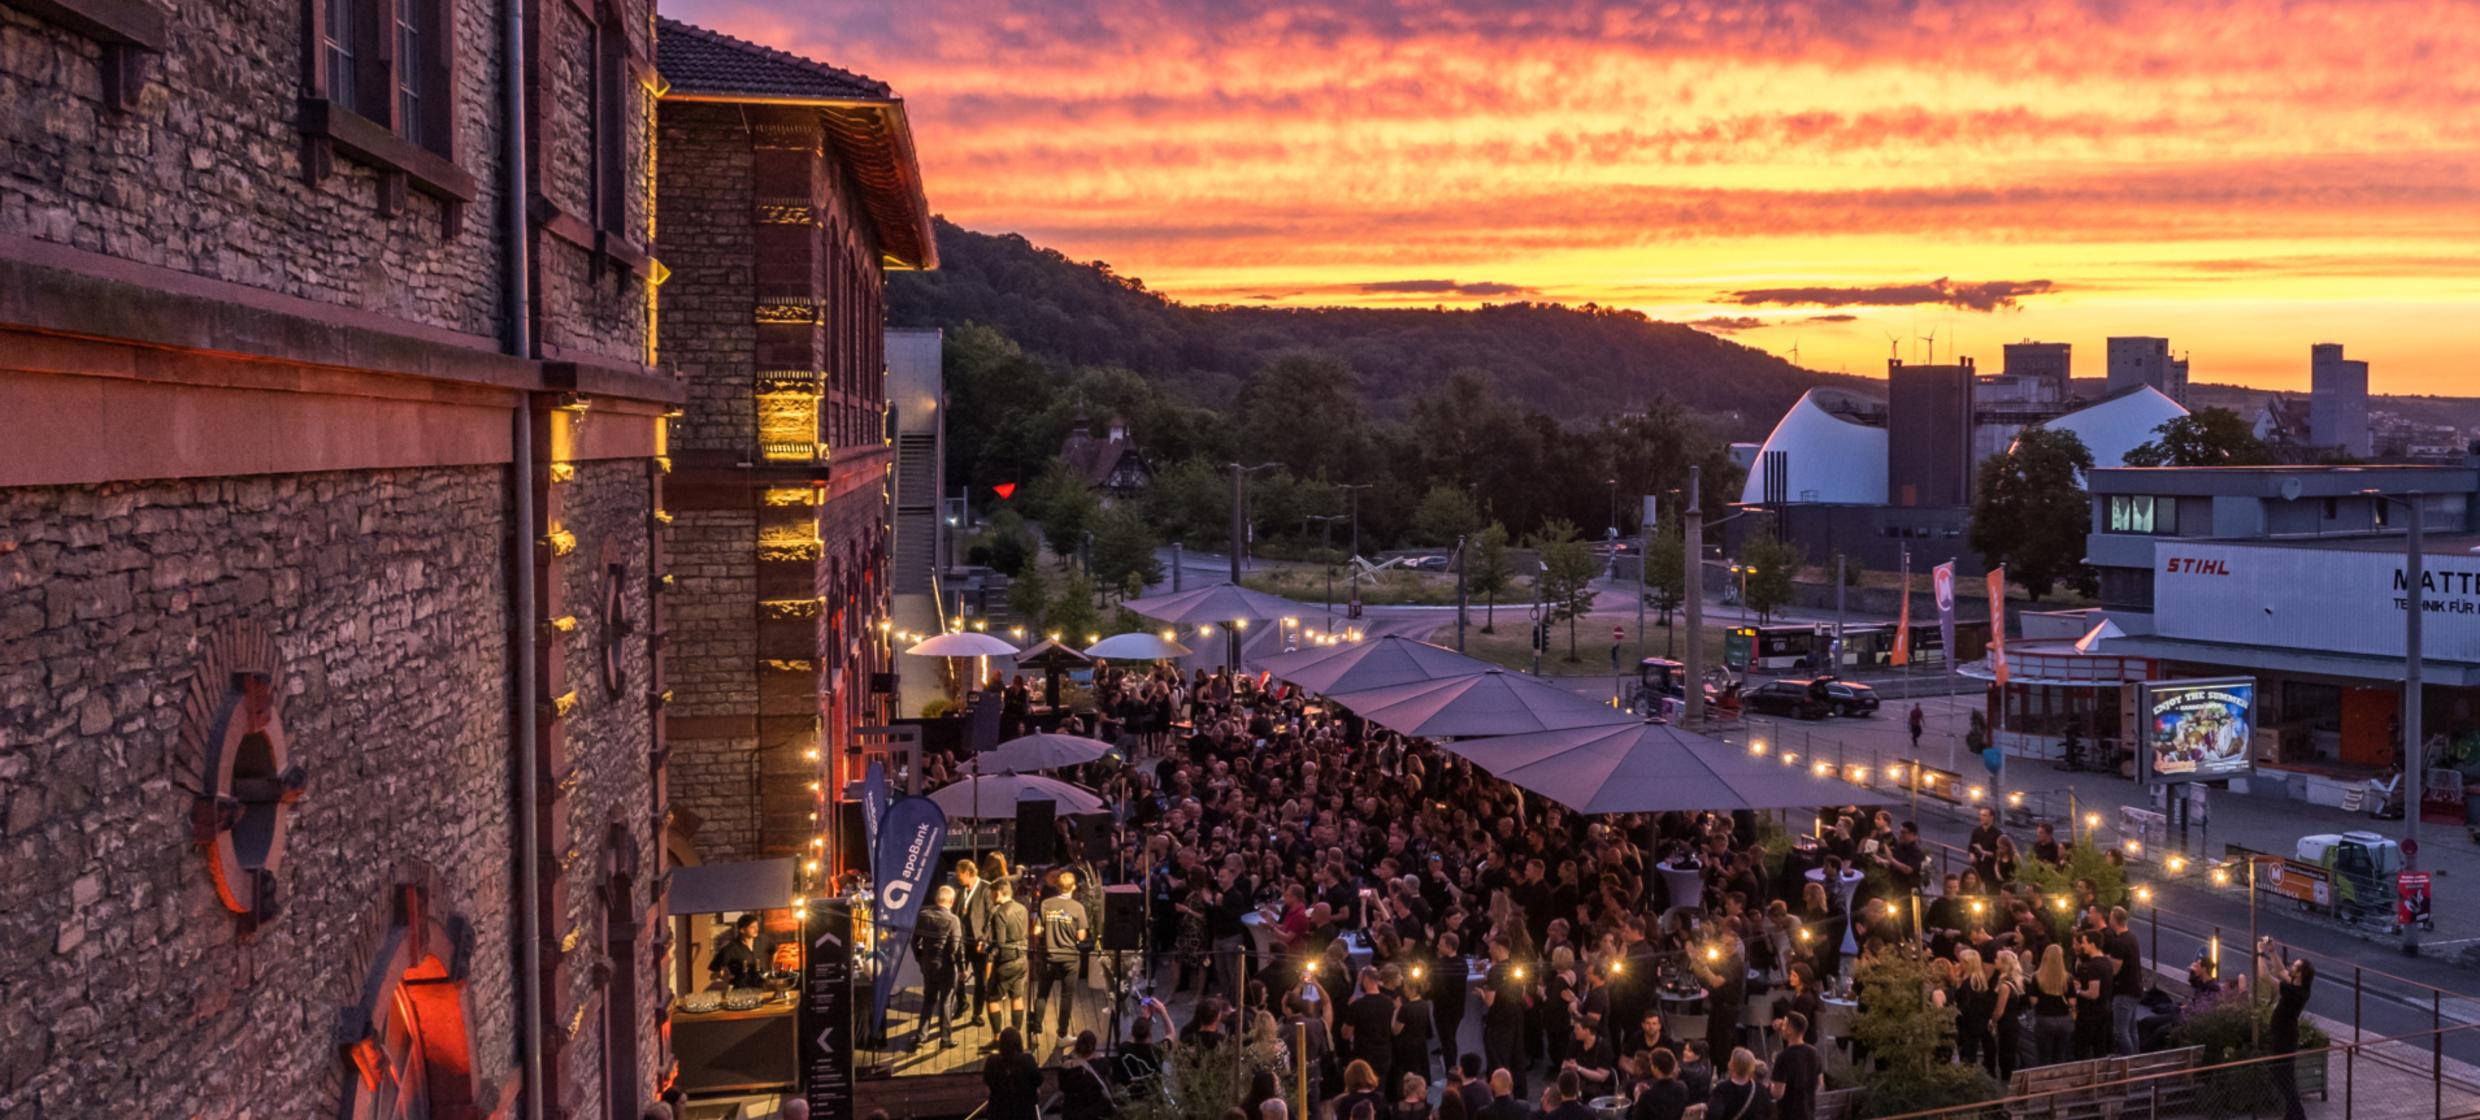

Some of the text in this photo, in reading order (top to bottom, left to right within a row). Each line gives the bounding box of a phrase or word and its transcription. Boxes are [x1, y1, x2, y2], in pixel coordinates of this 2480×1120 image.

[2167, 558, 2230, 576] STIHL
[2449, 599, 2474, 614] FÜR
[2153, 695, 2182, 715] ENJOY
[2185, 691, 2205, 701] THE
[2208, 691, 2249, 709] SUMMER
[902, 822, 930, 879] apoBank
